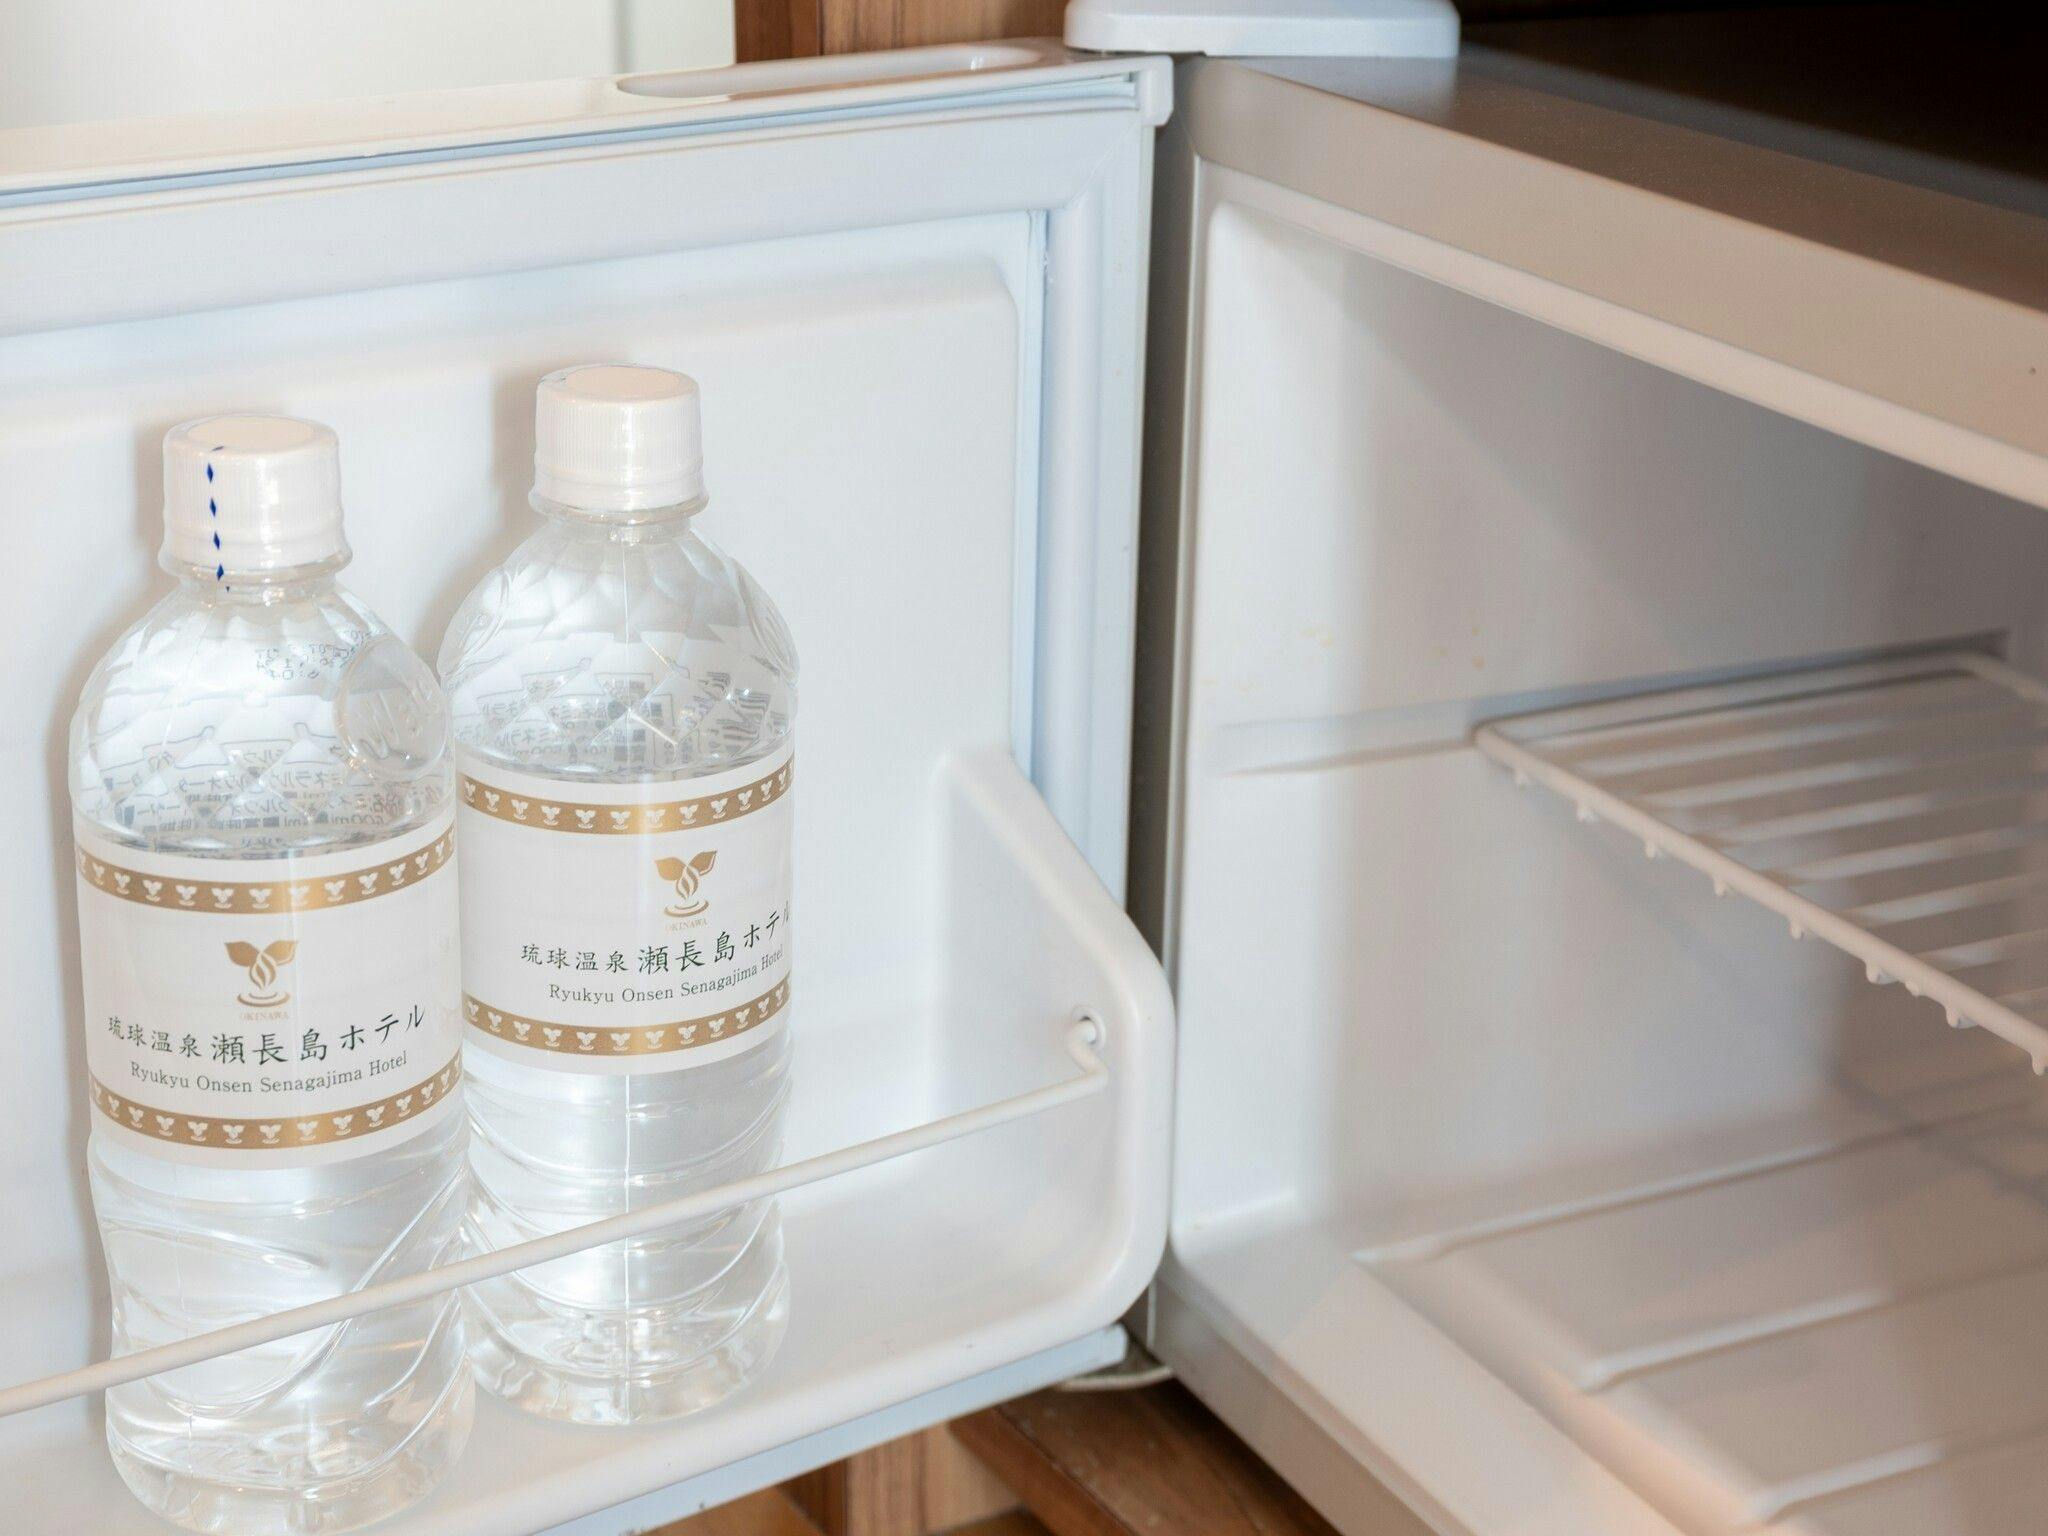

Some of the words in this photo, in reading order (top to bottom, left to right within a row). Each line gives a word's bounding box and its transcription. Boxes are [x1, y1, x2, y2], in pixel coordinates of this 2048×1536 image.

[548, 984, 614, 1005] Ryukyu
[621, 986, 674, 1003] Onsen
[680, 963, 758, 997] Senagajima
[129, 1061, 190, 1090] Ryukyu
[196, 1074, 252, 1094] Onsen
[260, 1068, 363, 1093] Senagajima
[368, 1050, 409, 1081] Hotel
